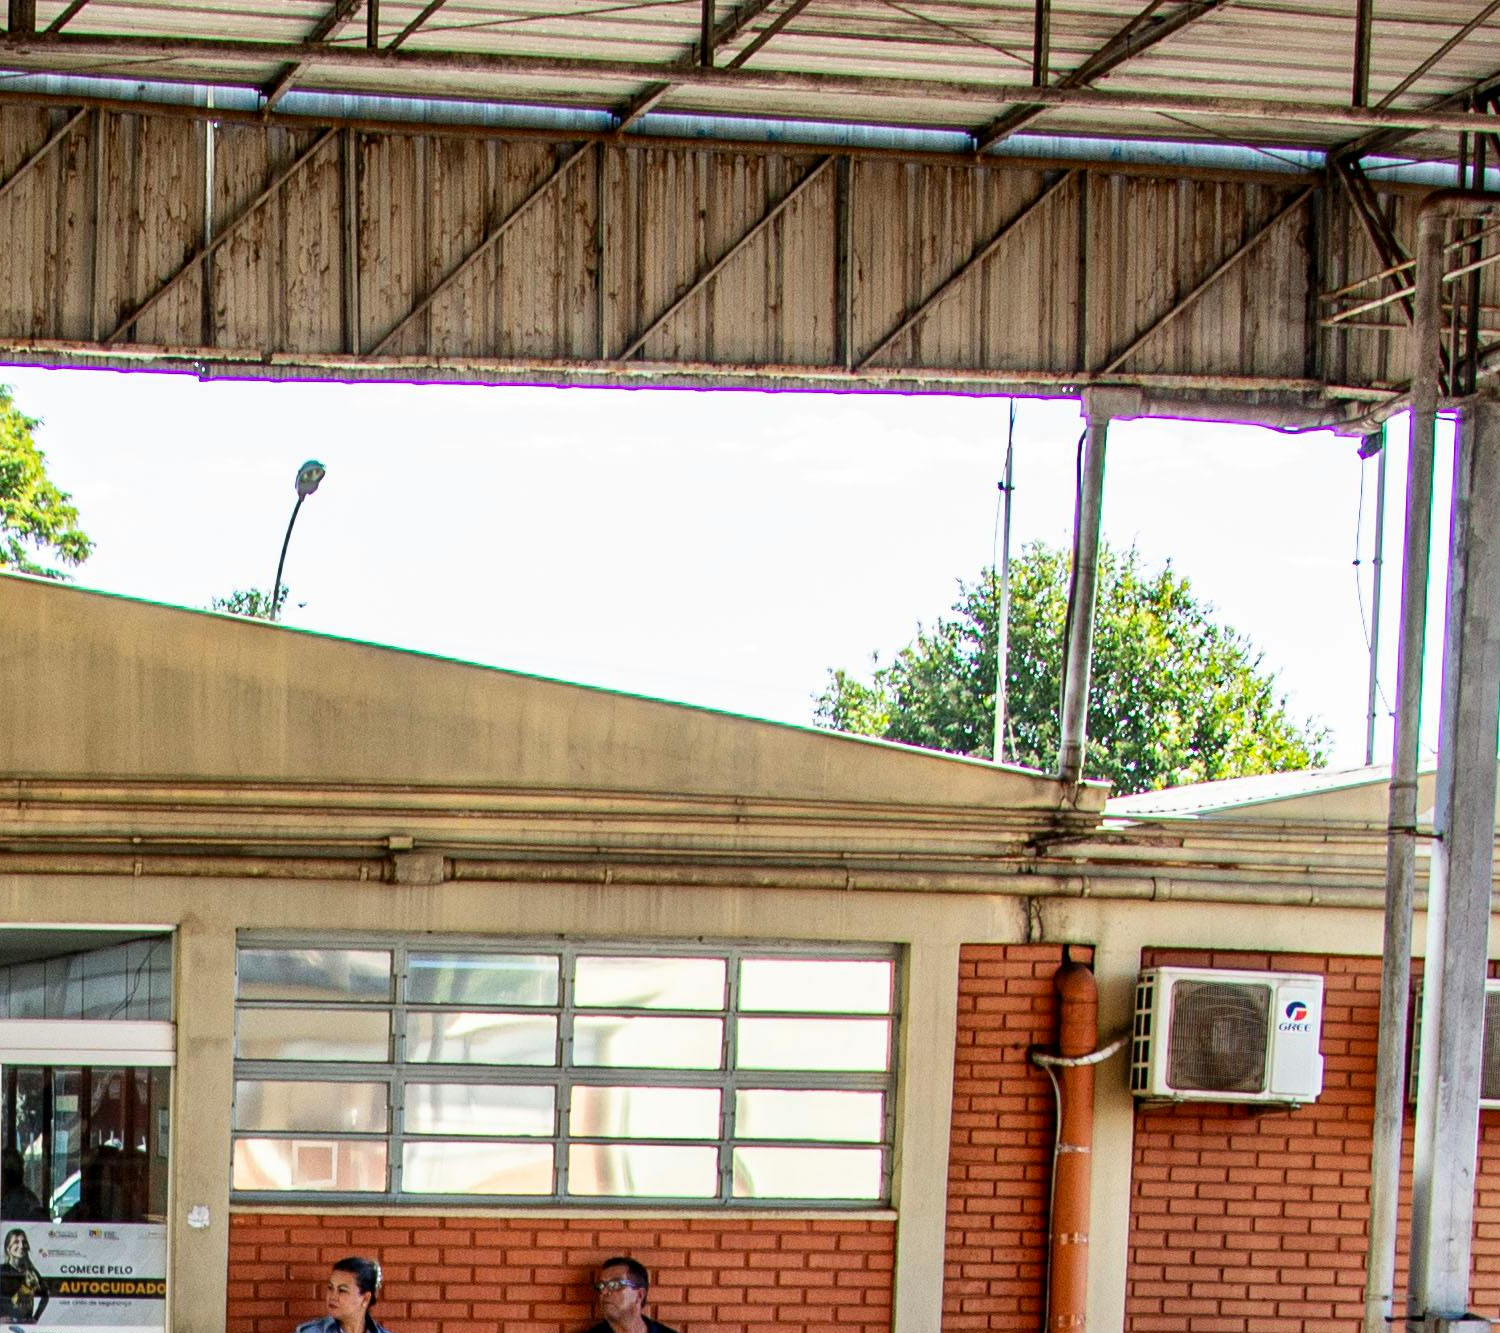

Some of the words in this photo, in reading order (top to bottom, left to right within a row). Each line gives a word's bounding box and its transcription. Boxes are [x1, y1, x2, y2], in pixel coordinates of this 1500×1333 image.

[1278, 1023, 1311, 1032] GREE
[60, 1264, 105, 1274] COMECE
[108, 1265, 133, 1275] PELO
[59, 1282, 166, 1295] AUTOCUIDADO
